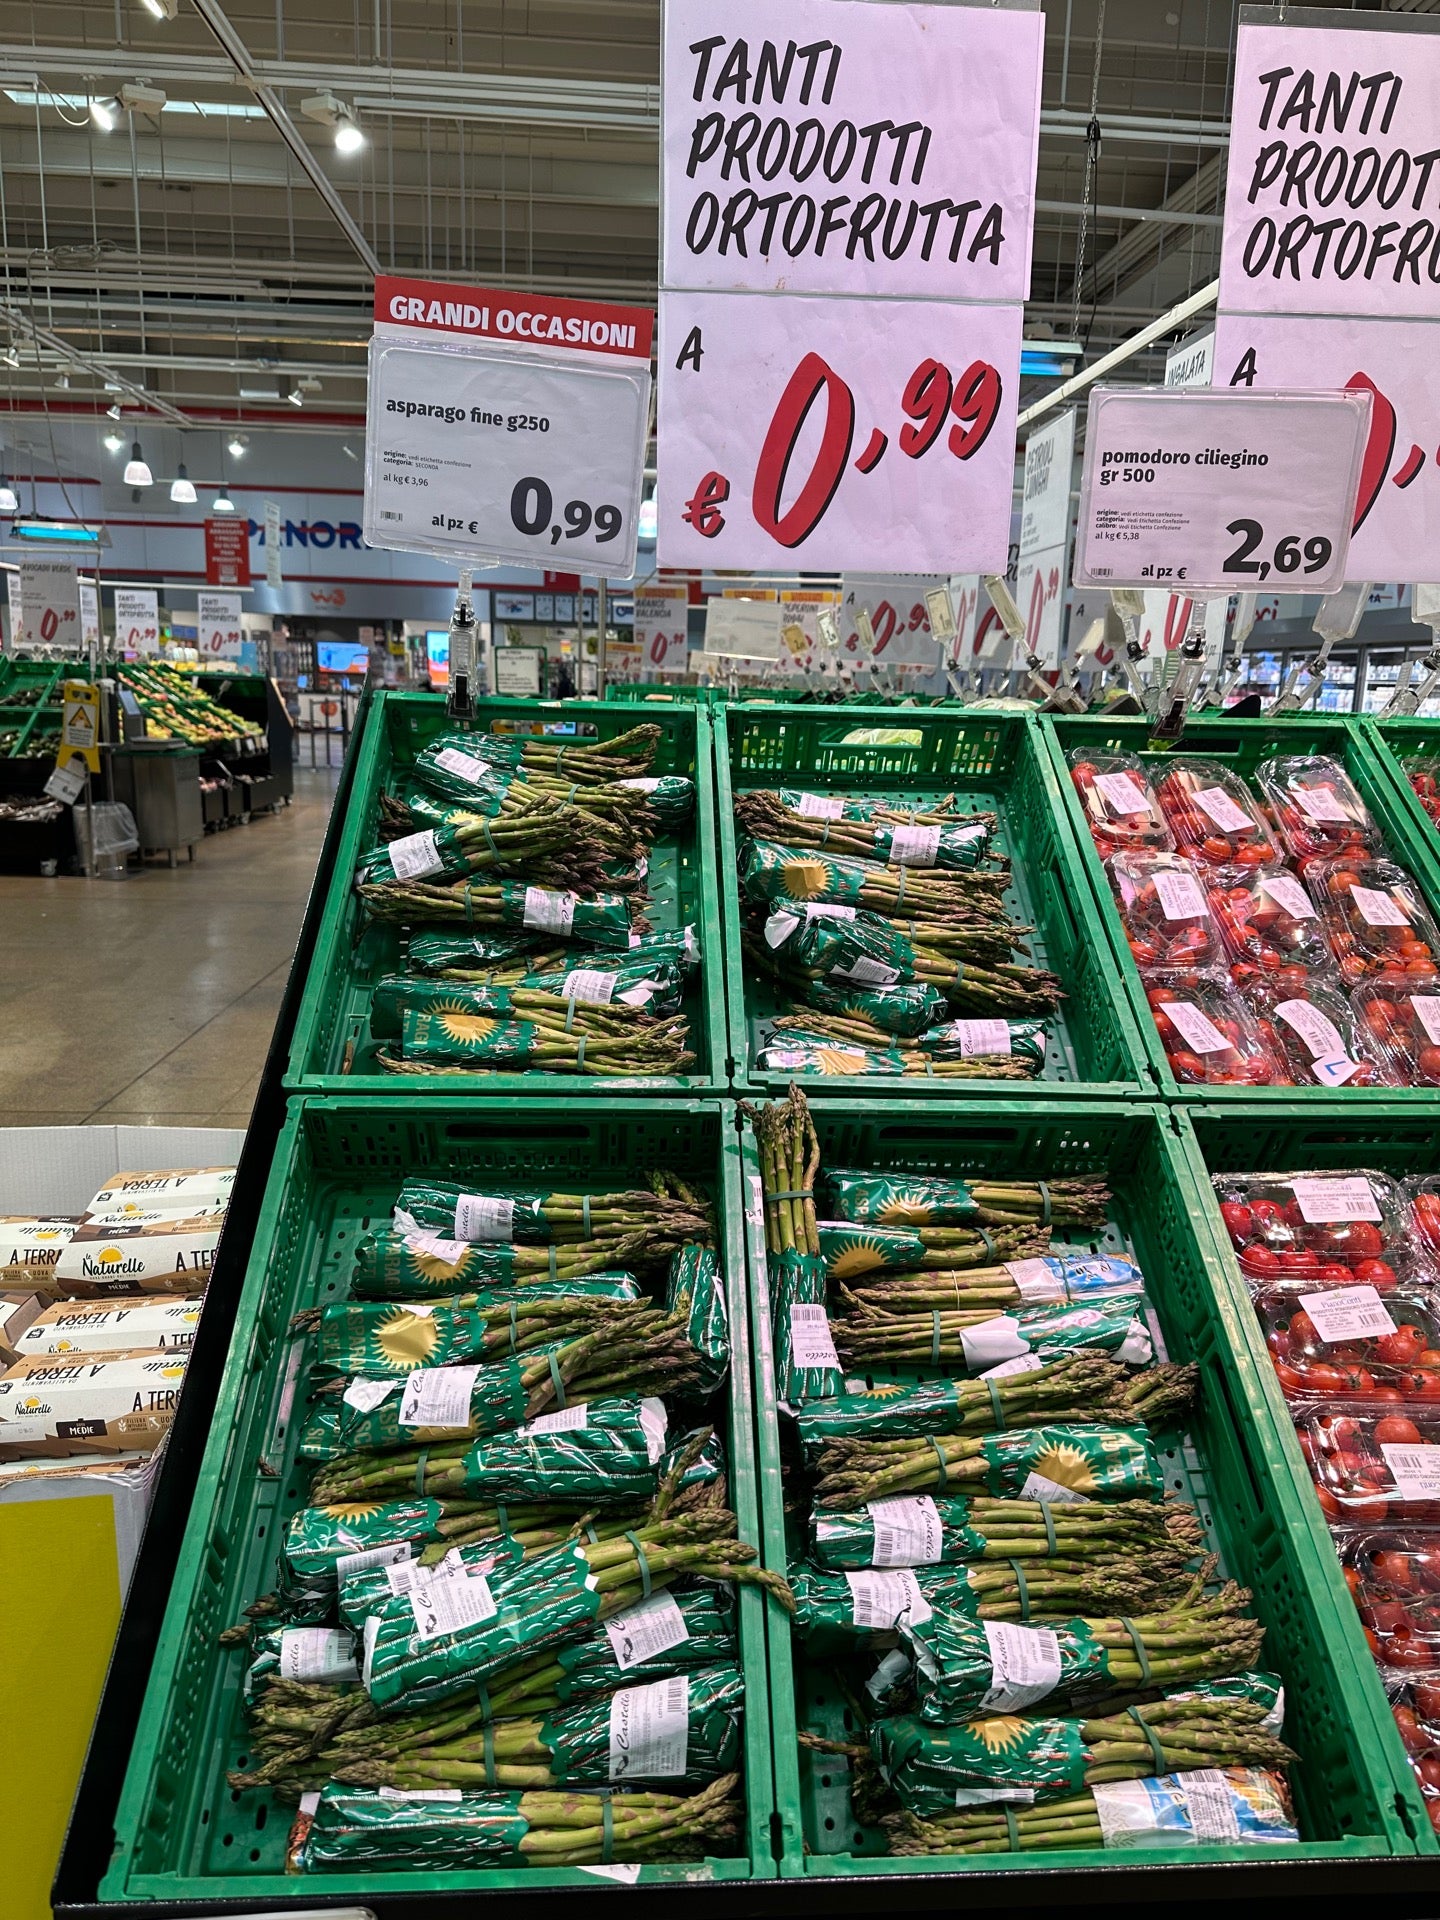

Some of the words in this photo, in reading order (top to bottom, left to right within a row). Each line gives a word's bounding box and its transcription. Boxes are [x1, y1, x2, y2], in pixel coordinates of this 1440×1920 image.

[689, 35, 843, 105] TANTI
[1259, 66, 1403, 136] TANTI
[686, 112, 932, 186] PRODOTTI
[1247, 140, 1440, 211] PRODOT
[686, 189, 1005, 266] ORTOFRUTTA
[389, 296, 489, 330] GRANDI
[496, 309, 636, 349] OCCASIONI
[676, 326, 705, 372] A
[1229, 347, 1258, 387] A
[386, 398, 466, 423] asparago
[470, 406, 503, 427] fine
[507, 413, 551, 433] g250
[383, 450, 407, 459] origine:
[420, 456, 443, 464] etichetta
[444, 460, 472, 468] confezione
[682, 471, 731, 539] €
[752, 352, 1003, 549] 0,99
[1101, 448, 1191, 467] pomodoro
[1194, 449, 1269, 470] ciliegino
[383, 458, 413, 466] categoria:
[415, 462, 439, 470] SECONDA
[383, 474, 391, 482] al
[393, 474, 403, 485] kg
[411, 478, 429, 487] 3,96
[1099, 469, 1120, 486] gr
[1122, 468, 1156, 484] 500
[510, 476, 623, 546] 0,99
[1096, 508, 1119, 517] origine:
[247, 519, 370, 550] PNOR
[431, 514, 445, 527] al
[447, 518, 463, 531] pz
[468, 521, 479, 535] €
[1095, 532, 1103, 540] al
[1105, 532, 1115, 541] kg
[1122, 533, 1140, 541] 5,38
[1222, 518, 1333, 582] 2,69
[1141, 564, 1154, 577] al
[1156, 567, 1173, 579] pz
[1177, 567, 1188, 580] €
[122, 1178, 170, 1190] TERRA
[10, 1249, 18, 1265] A
[82, 1257, 146, 1277] Naturelle
[176, 1251, 188, 1272] A
[1320, 1296, 1361, 1309] PianoConti
[55, 1312, 107, 1327] TERRA
[26, 1365, 86, 1381] TERRA
[89, 1364, 106, 1377] A
[15, 1403, 52, 1416] Naturelle
[132, 1392, 143, 1412] A
[69, 1425, 95, 1435] MEDIE
[921, 1510, 934, 1559] Castello
[995, 1631, 1010, 1681] Castello
[616, 1693, 630, 1750] Castello
